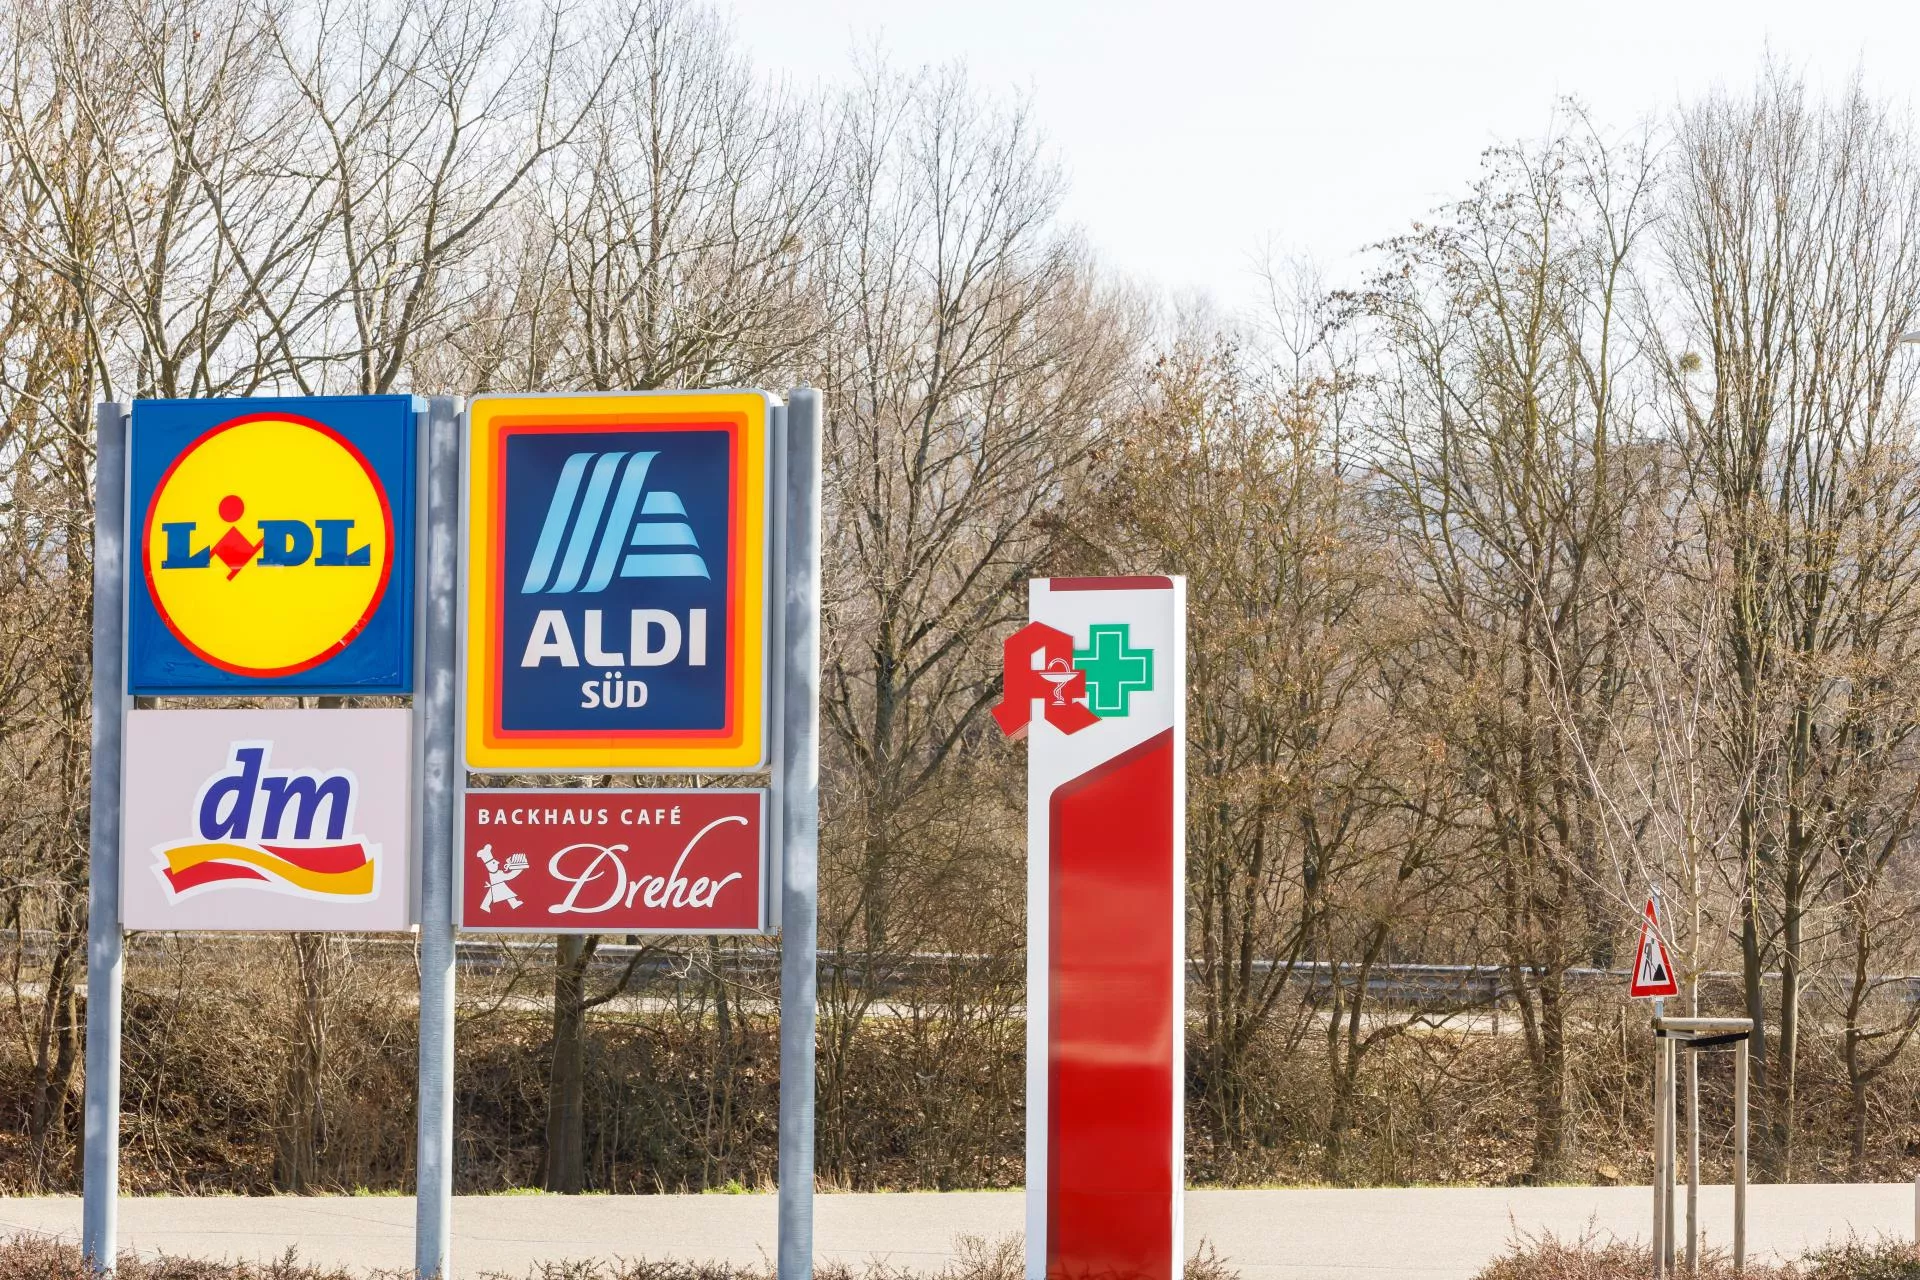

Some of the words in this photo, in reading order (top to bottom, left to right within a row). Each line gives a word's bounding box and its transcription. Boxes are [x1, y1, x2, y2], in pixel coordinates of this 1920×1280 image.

[520, 608, 707, 668] ALDI
[580, 671, 649, 709] SÜD
[199, 747, 351, 841] dm
[477, 808, 609, 825] BACKHAUS
[620, 805, 682, 825] CAFÉ
[547, 815, 749, 914] Dreher
